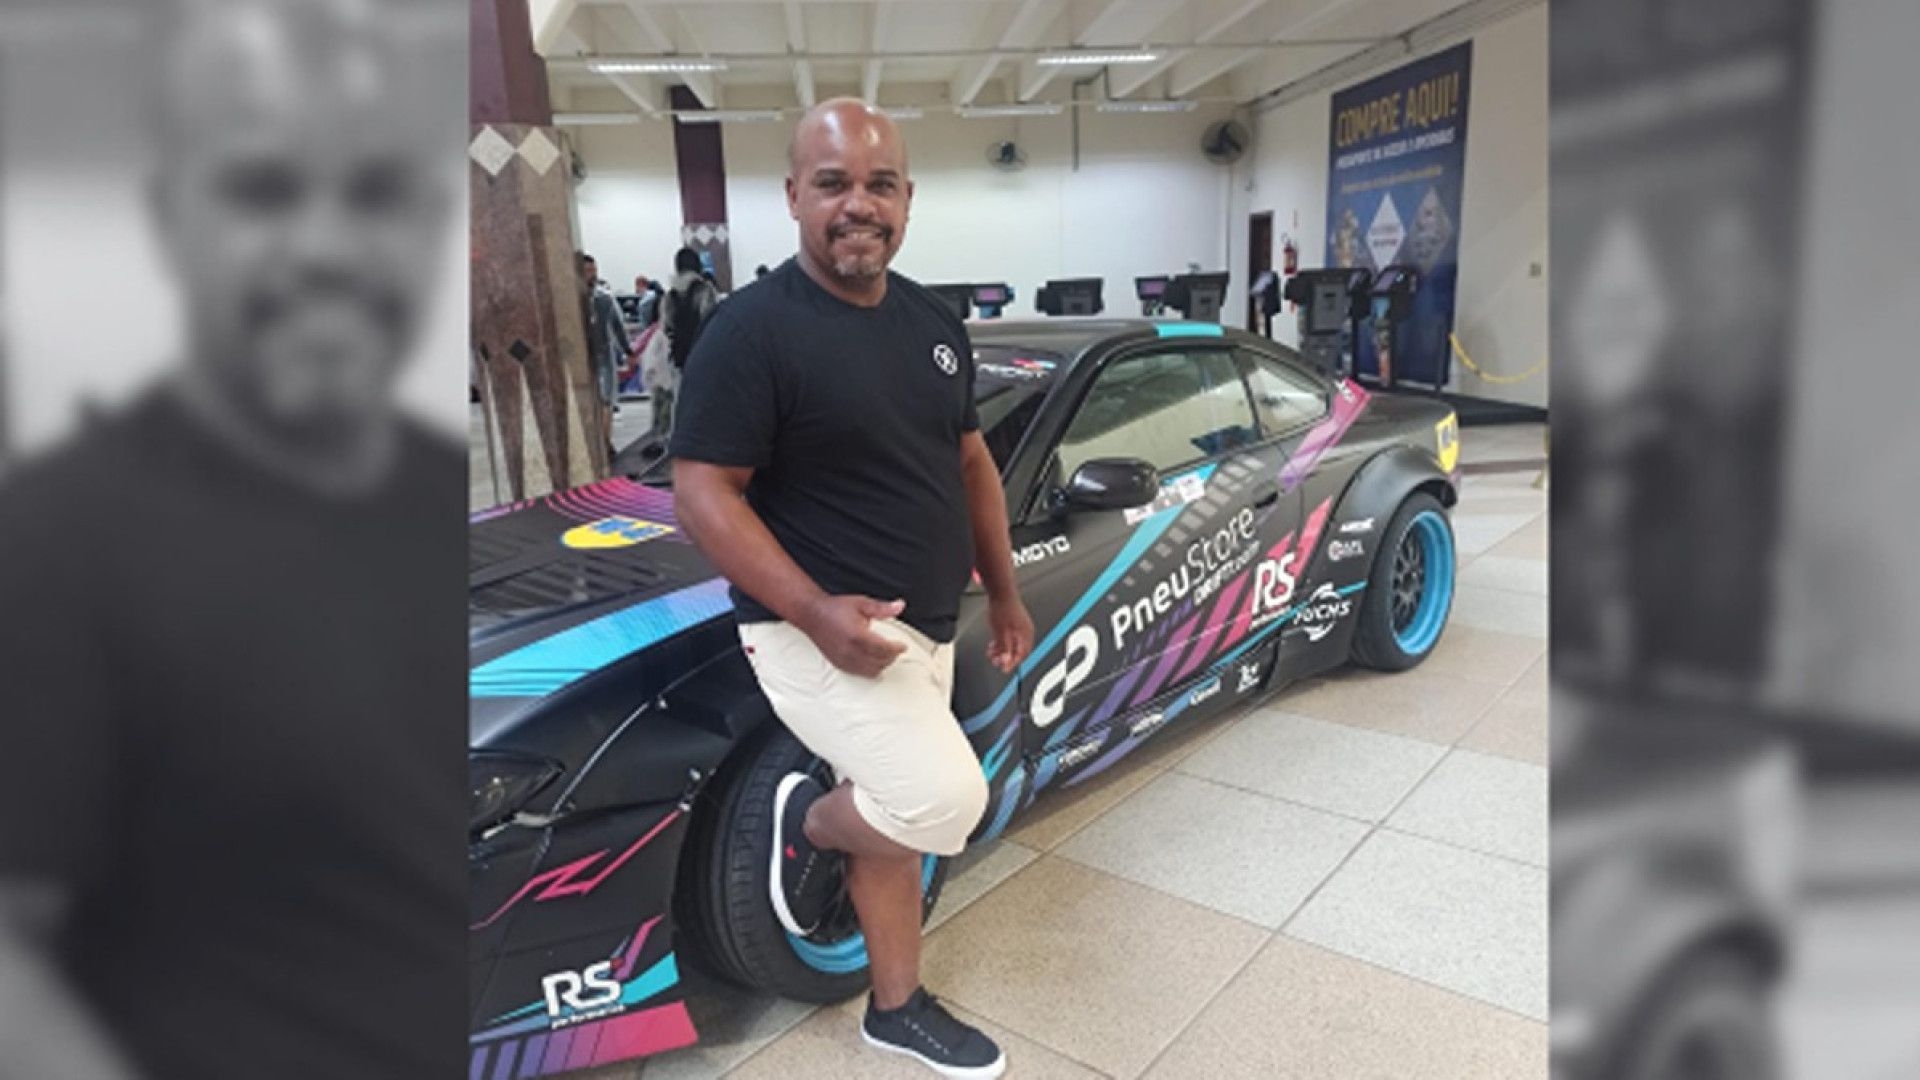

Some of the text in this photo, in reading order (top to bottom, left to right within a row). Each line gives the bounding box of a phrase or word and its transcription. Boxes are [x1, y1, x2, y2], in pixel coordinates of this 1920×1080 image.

[1337, 91, 1401, 147] COMPRE
[1111, 508, 1256, 650] PneuStore
[1251, 551, 1296, 616] RS
[542, 960, 621, 1017] RS
